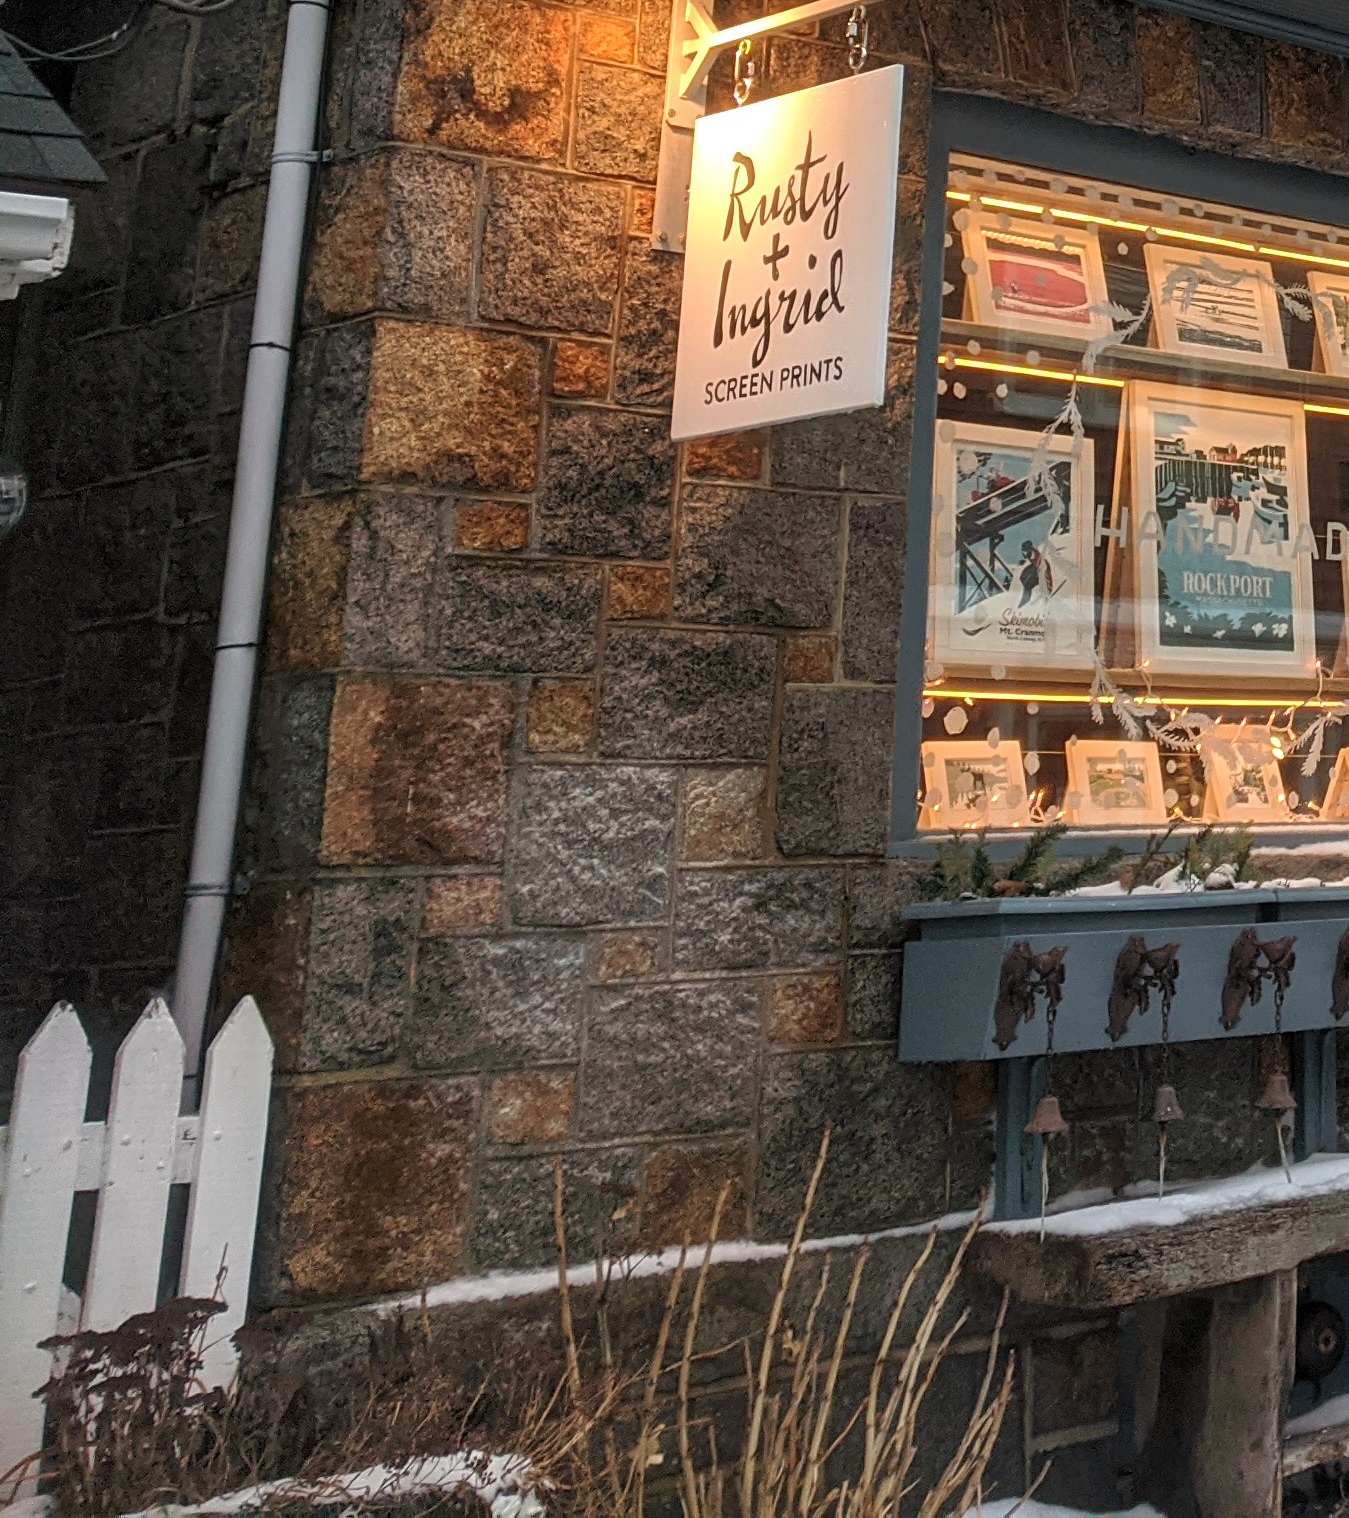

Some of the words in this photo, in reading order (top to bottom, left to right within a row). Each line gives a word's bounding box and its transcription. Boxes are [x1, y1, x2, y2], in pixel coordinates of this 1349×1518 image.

[722, 129, 850, 242] Rusty
[763, 232, 790, 282] +
[712, 248, 846, 369] Ingrid
[703, 369, 775, 406] SCREEN
[779, 355, 845, 393] PRINTS
[1183, 570, 1274, 599] ROCKPORT
